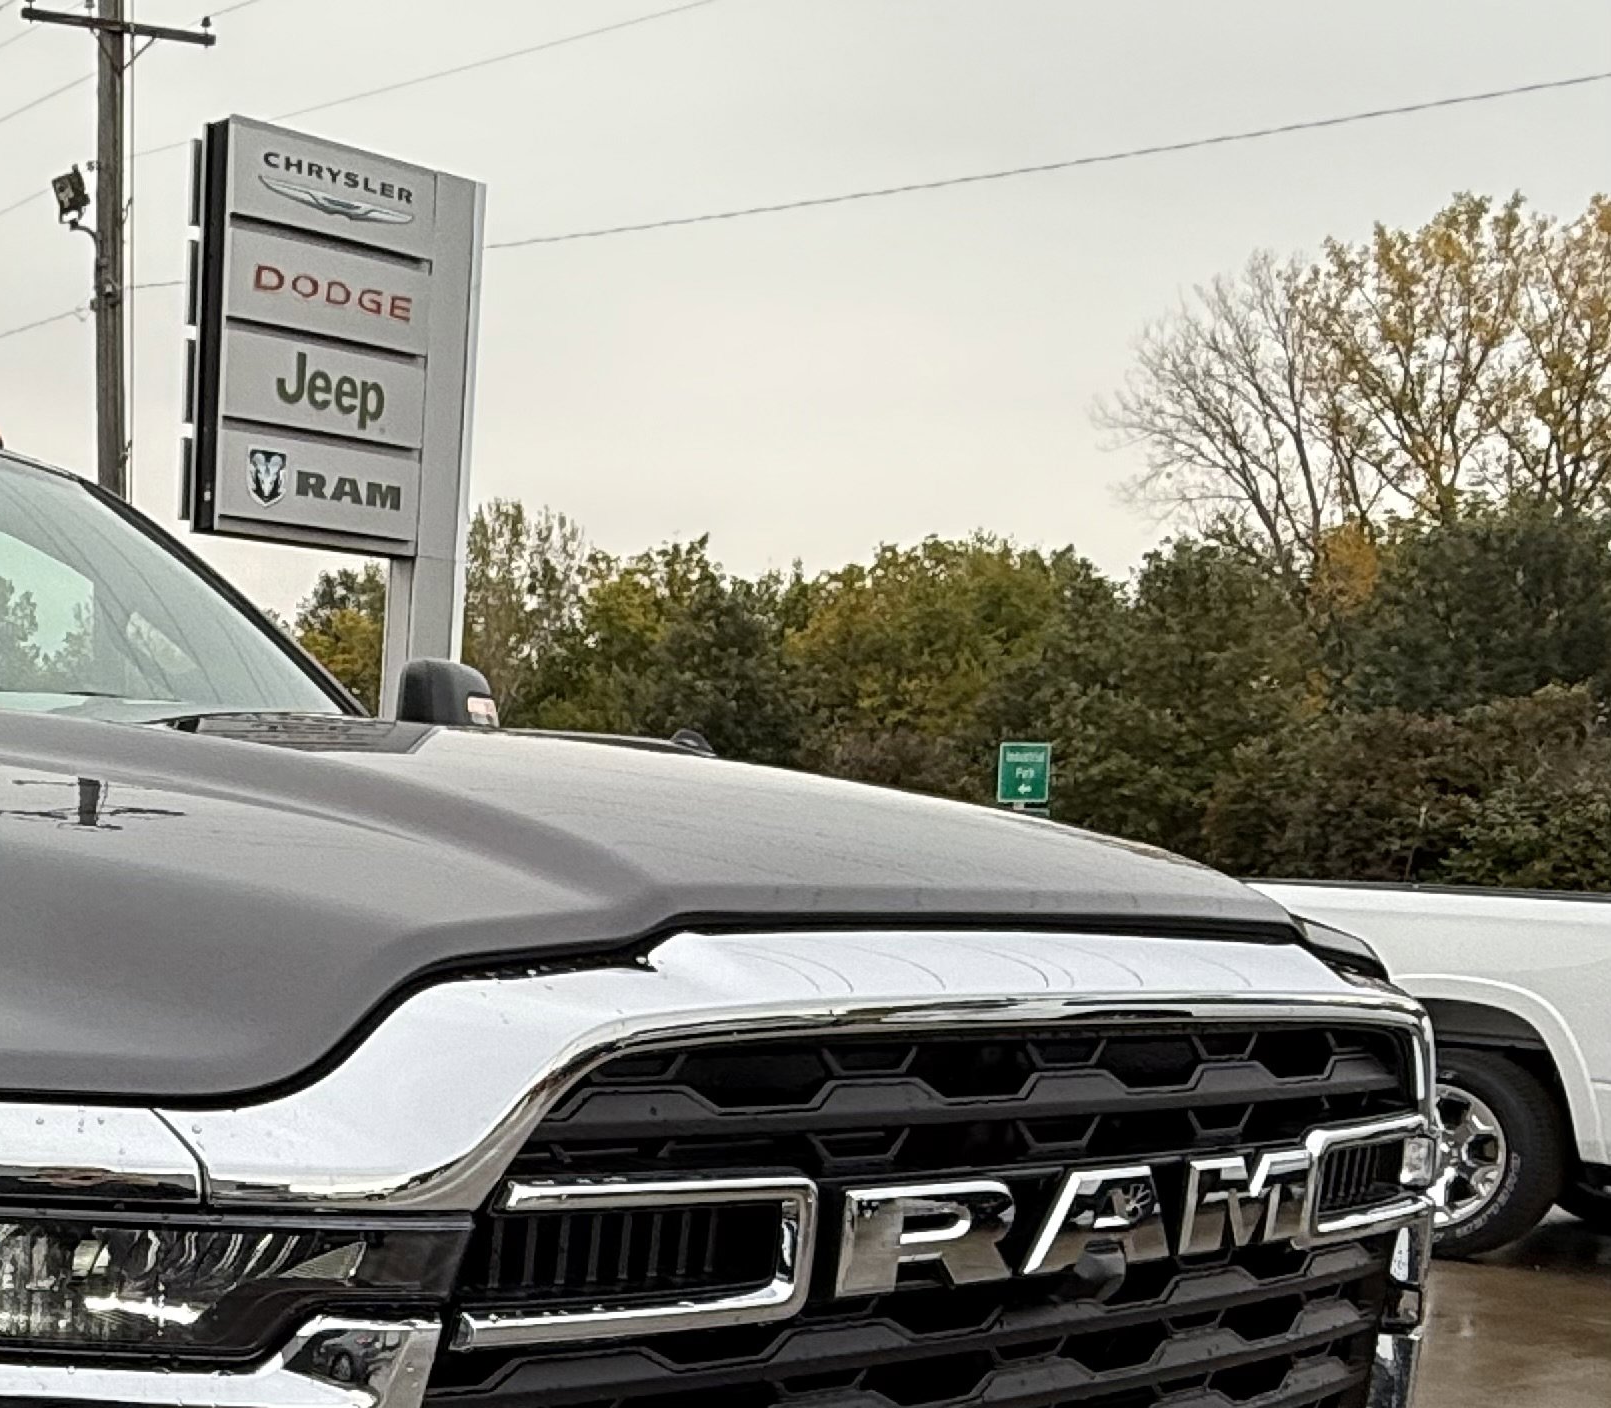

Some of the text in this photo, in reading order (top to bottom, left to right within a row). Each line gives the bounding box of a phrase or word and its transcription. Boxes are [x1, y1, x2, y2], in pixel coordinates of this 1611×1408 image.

[262, 150, 414, 205] CHRYSLER
[253, 263, 413, 322] DODGE
[276, 351, 386, 430] Jeep
[295, 470, 402, 512] RAM
[835, 1149, 1311, 1298] RAM
